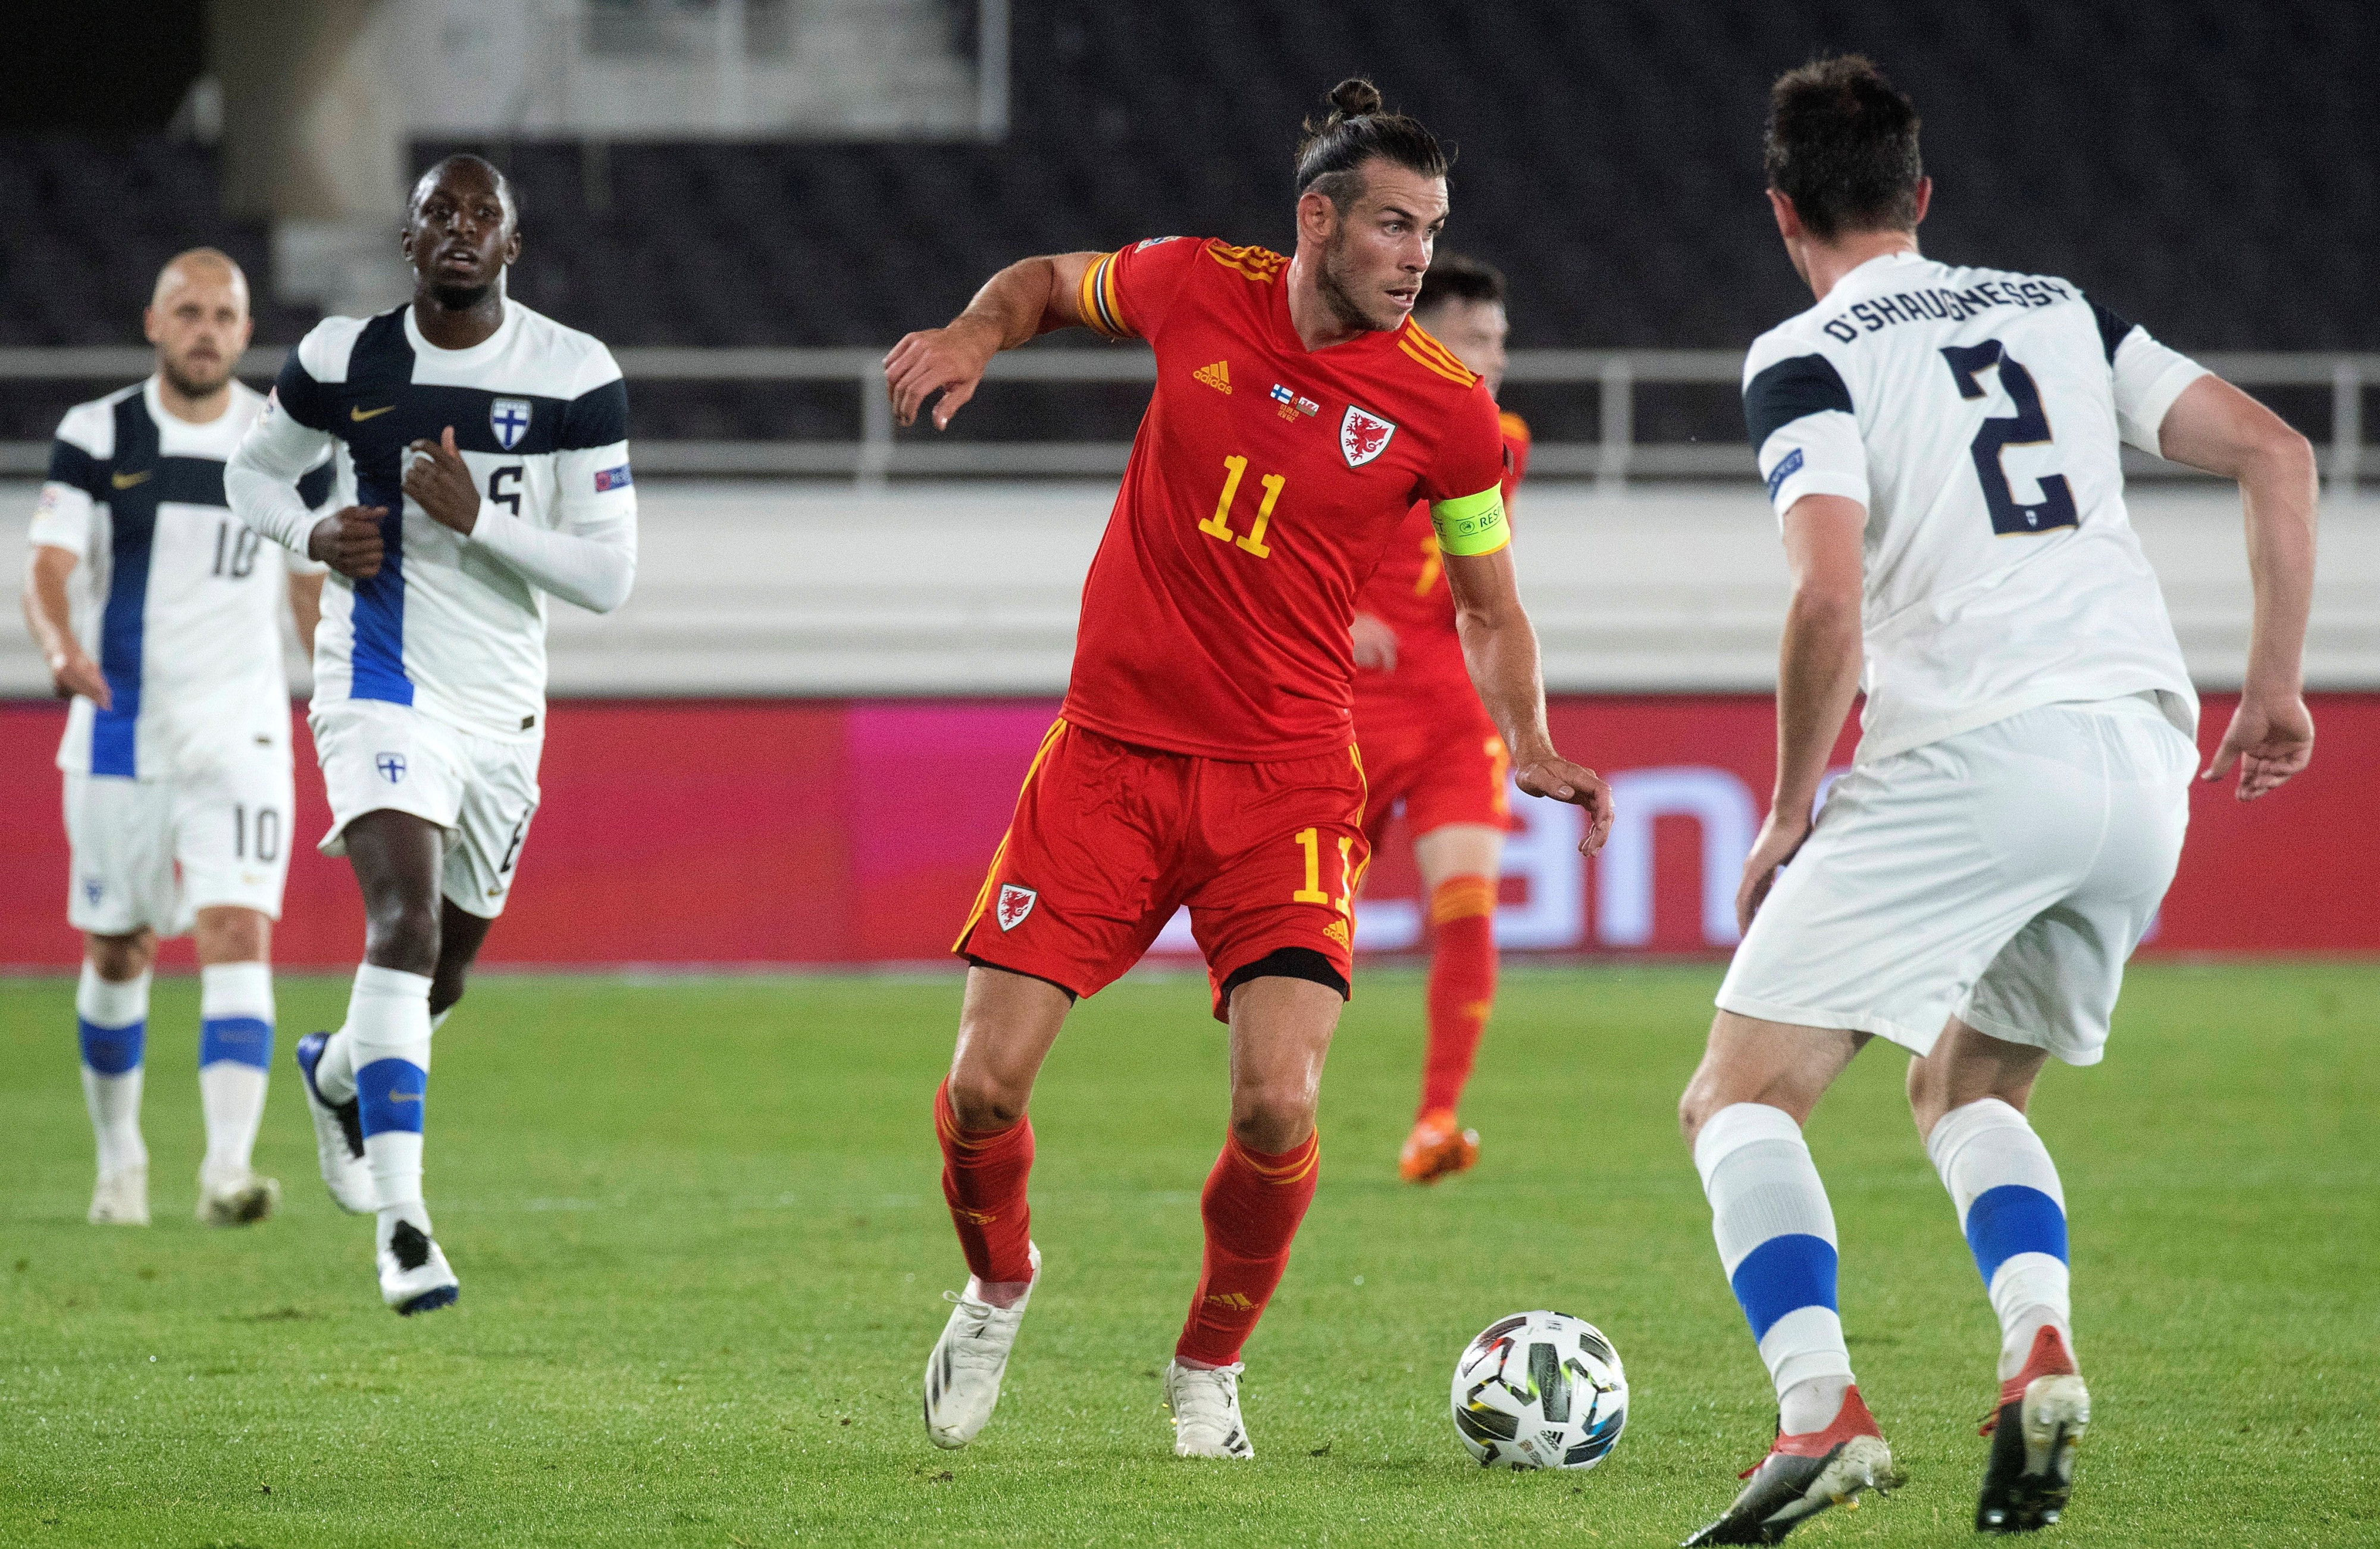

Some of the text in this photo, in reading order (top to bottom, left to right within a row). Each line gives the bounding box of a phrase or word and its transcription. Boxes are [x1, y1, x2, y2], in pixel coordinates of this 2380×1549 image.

[1193, 370, 1232, 395] adidas
[1937, 338, 2080, 539] 2
[1198, 455, 1286, 559] 11
[214, 520, 262, 579] 10
[236, 803, 278, 862] 10
[1293, 827, 1354, 921] 11
